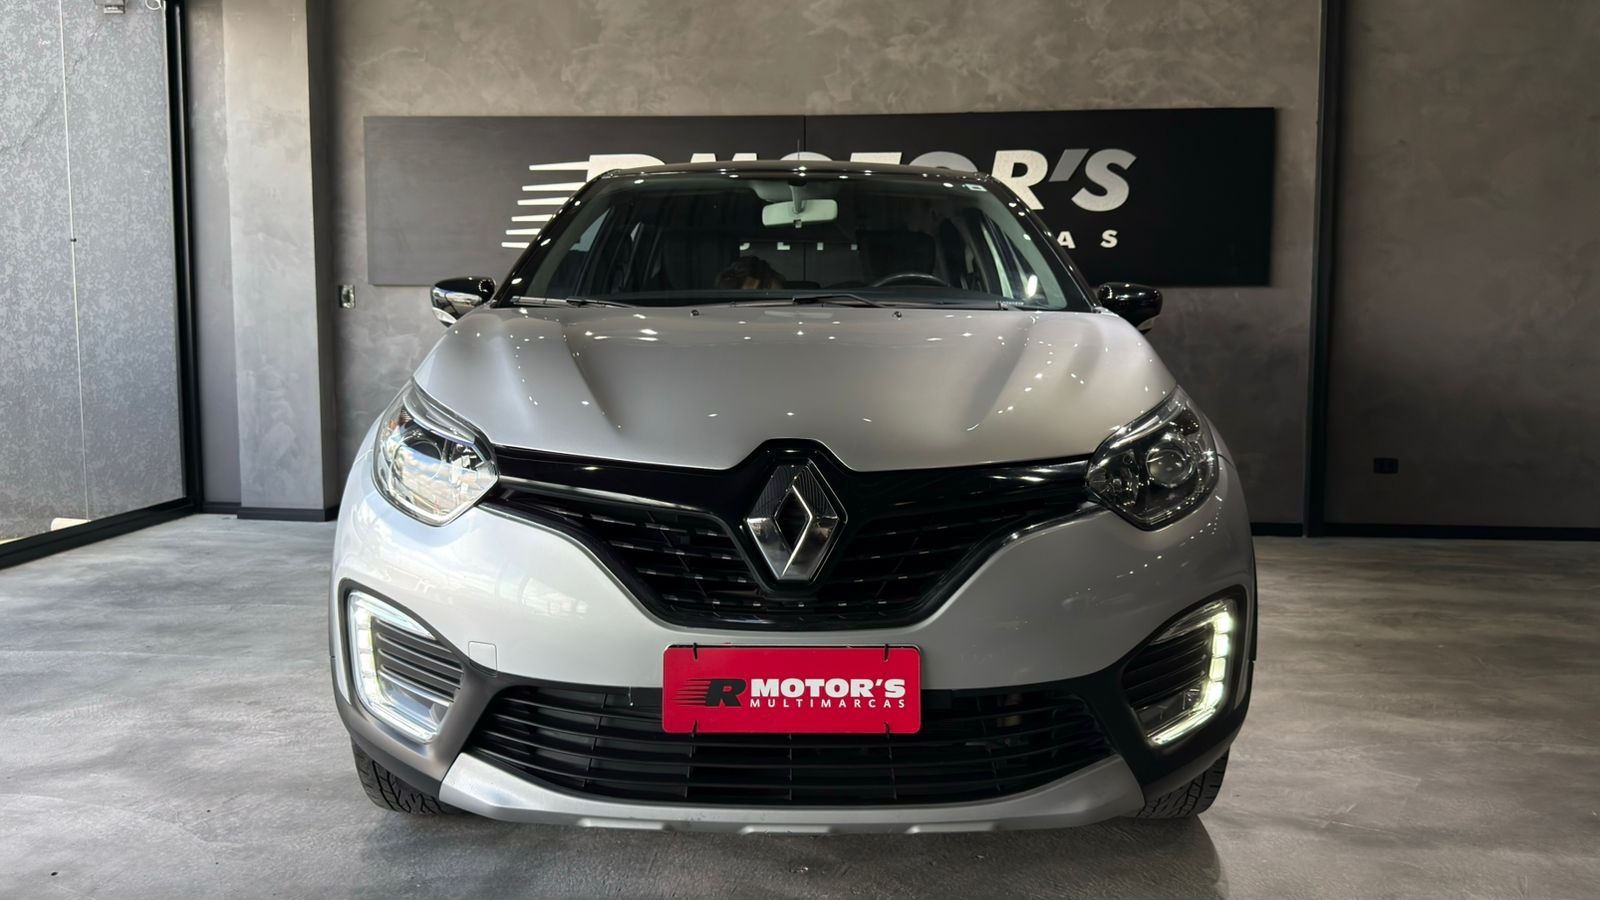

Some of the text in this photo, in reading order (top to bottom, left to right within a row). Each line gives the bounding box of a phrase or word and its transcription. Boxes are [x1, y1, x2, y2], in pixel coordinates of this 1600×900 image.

[705, 678, 906, 708] R MOTOR'S
[750, 699, 905, 708] MULTIMARCAS
